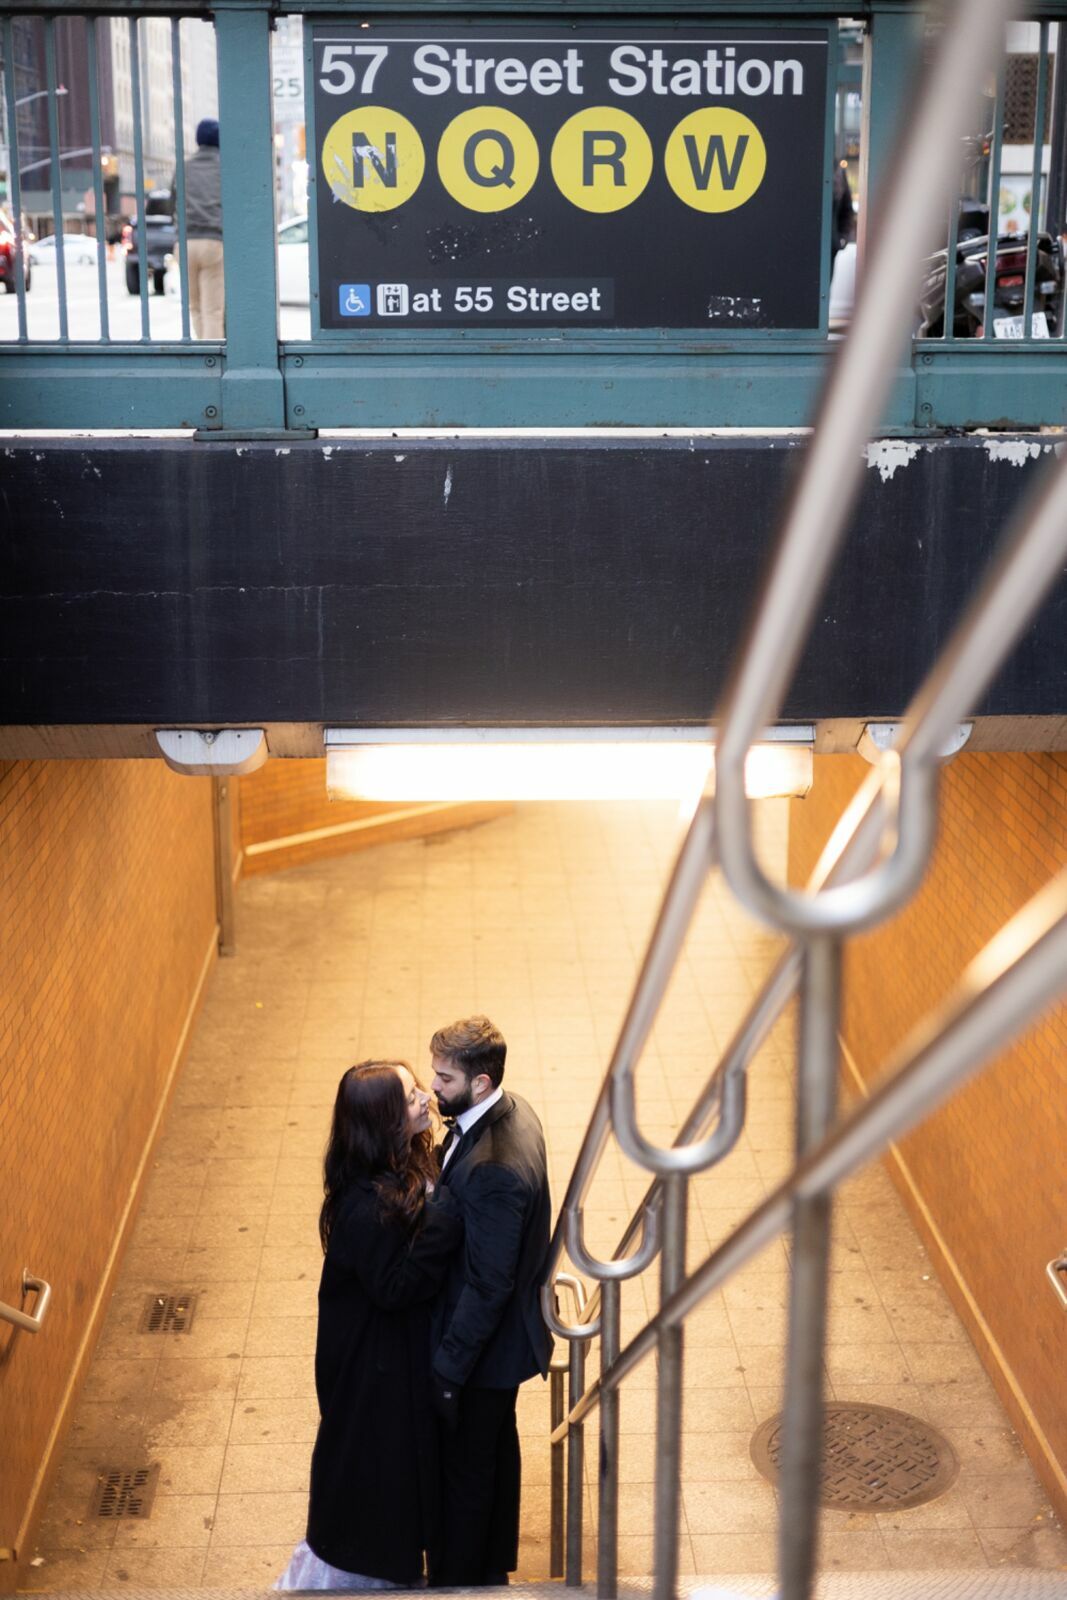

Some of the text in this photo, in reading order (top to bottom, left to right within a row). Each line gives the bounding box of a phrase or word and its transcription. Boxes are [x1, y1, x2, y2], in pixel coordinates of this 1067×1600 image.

[273, 78, 302, 98] 25
[318, 43, 804, 97] 57 Street Station
[352, 129, 750, 191] N Q R W
[412, 285, 601, 313] at 55 Street
